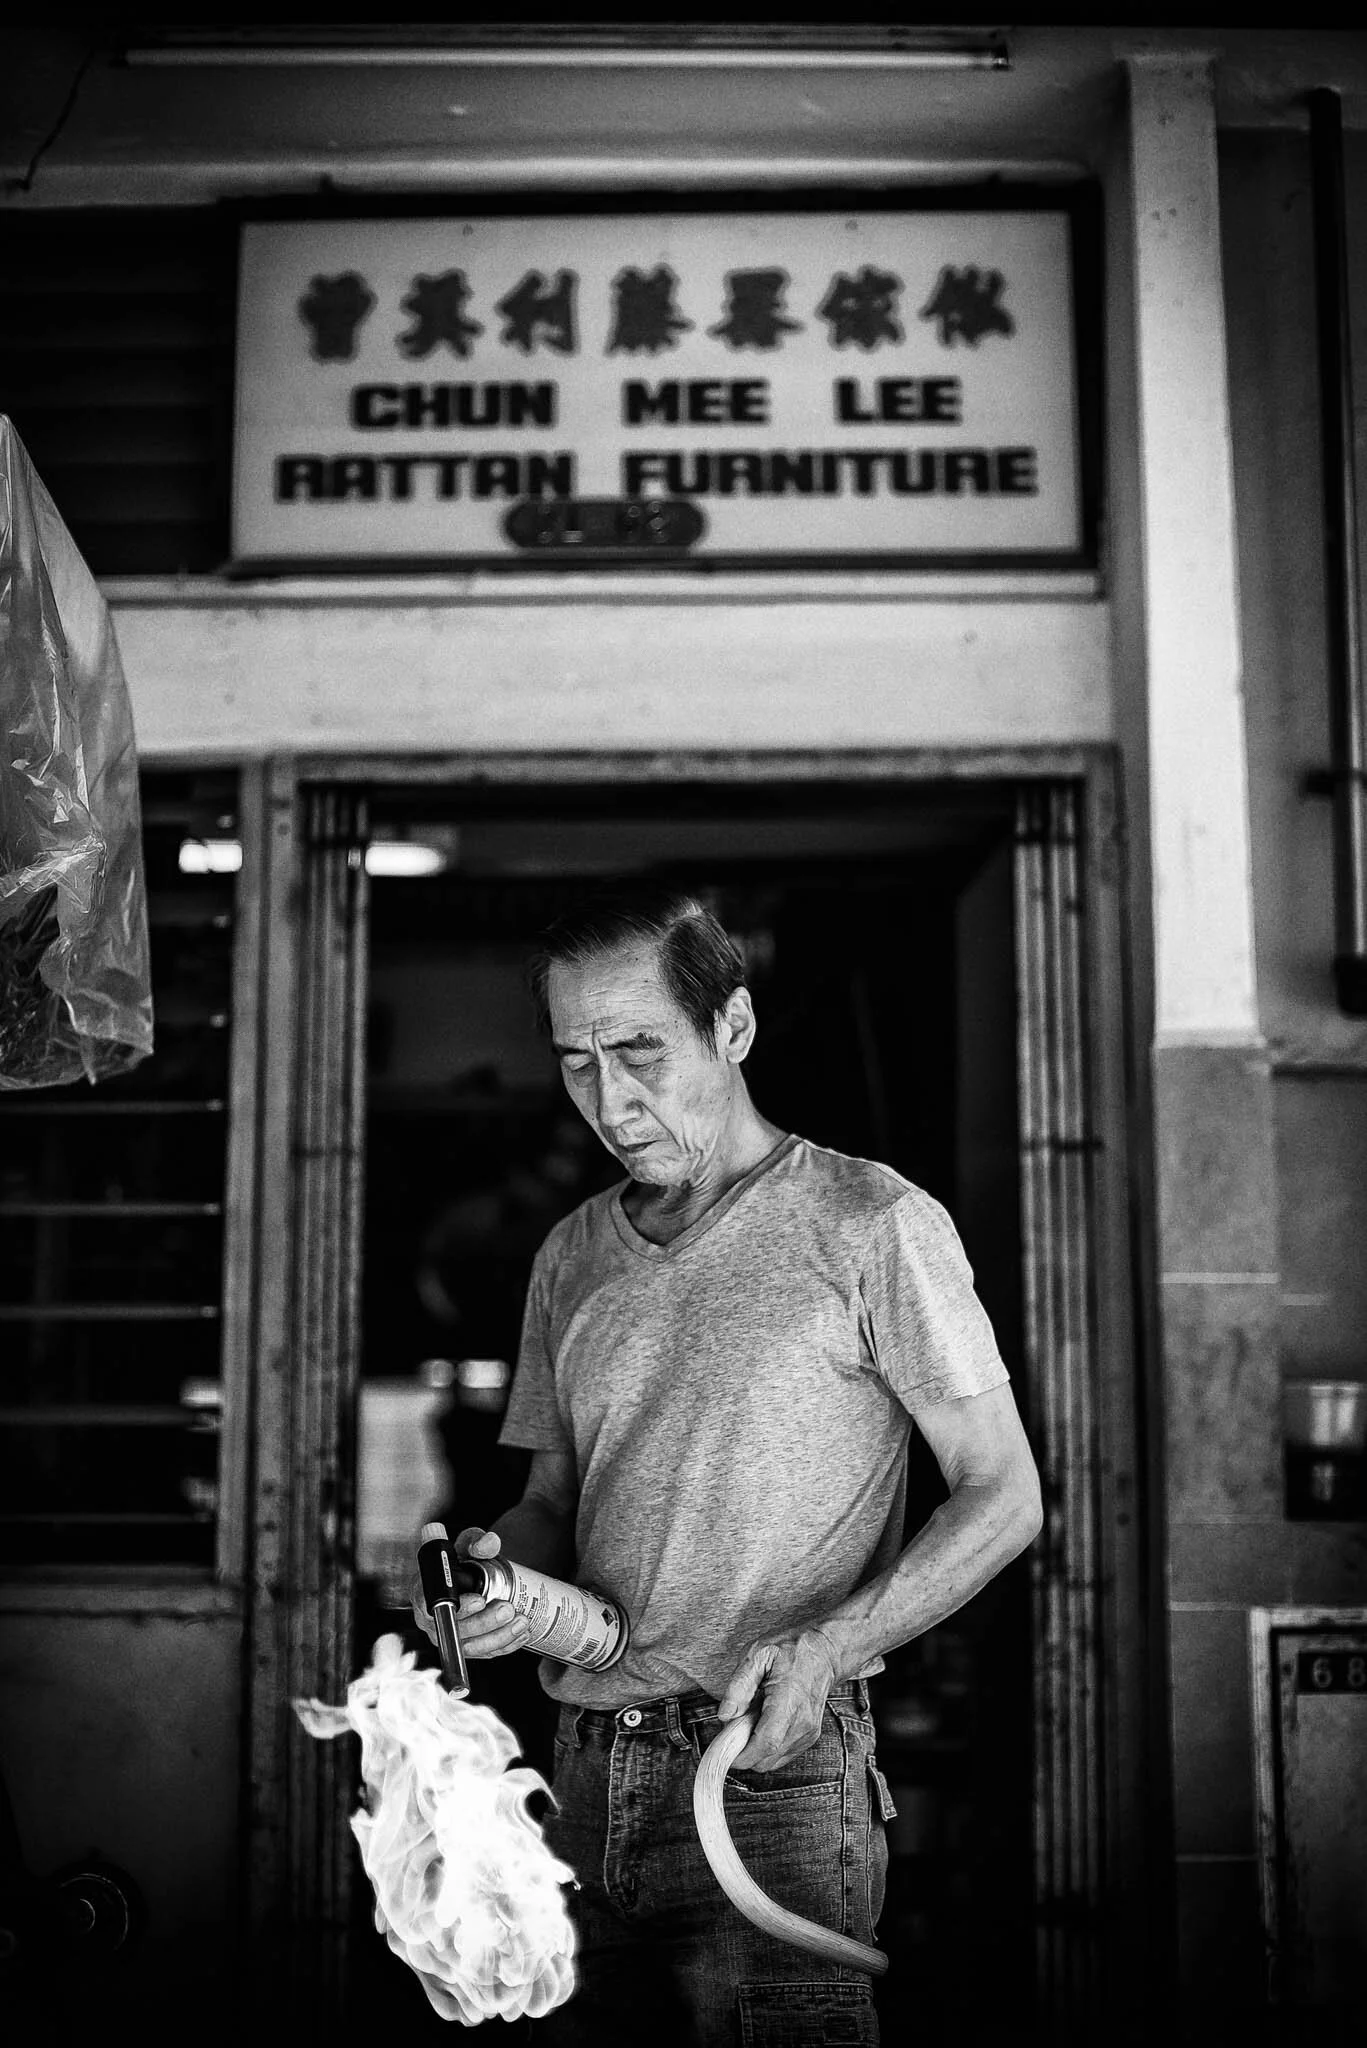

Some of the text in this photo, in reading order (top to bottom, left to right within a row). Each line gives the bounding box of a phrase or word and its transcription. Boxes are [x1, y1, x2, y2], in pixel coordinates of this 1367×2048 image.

[349, 376, 962, 430] CHUN MEE LEE
[274, 446, 1039, 502] RATTAN FURNITURE
